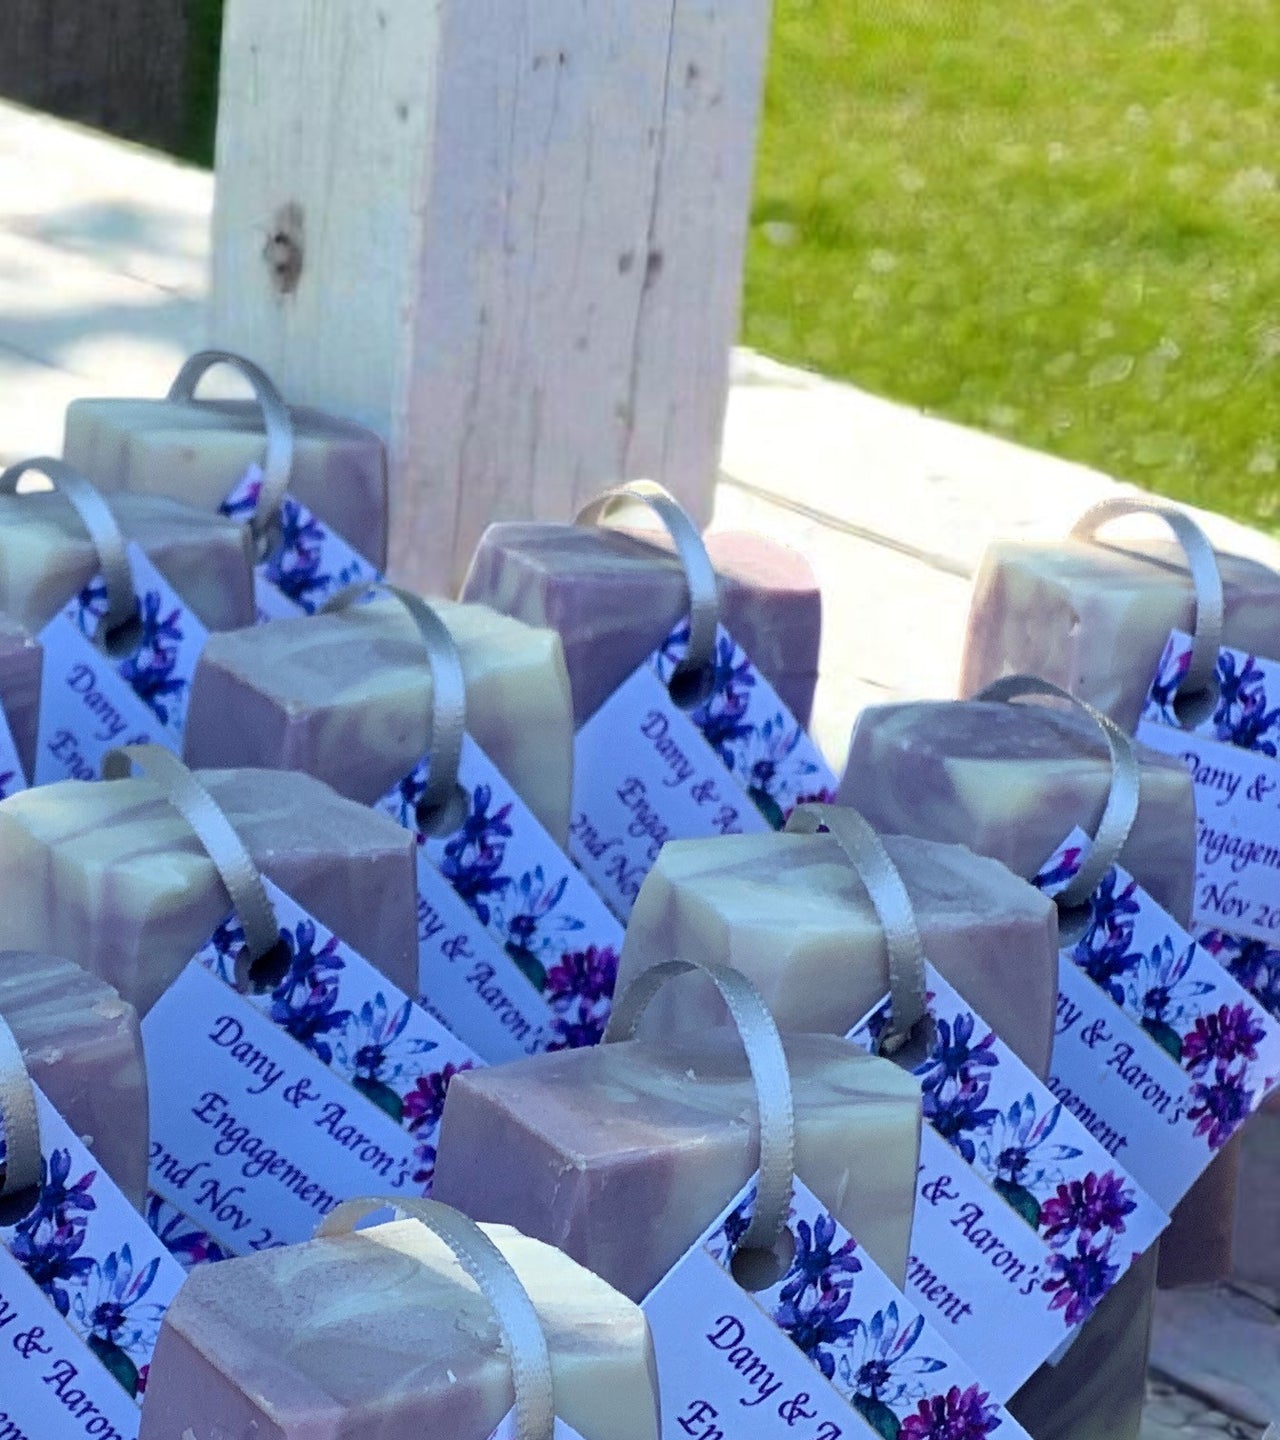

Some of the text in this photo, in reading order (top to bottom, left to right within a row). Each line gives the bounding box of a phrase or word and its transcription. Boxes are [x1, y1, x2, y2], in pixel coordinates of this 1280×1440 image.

[67, 663, 127, 742] Dany
[641, 710, 695, 787] Dany
[692, 780, 720, 805] &
[1247, 774, 1276, 802] &
[441, 935, 473, 962] &
[1200, 881, 1280, 930] Nov 20
[209, 1016, 414, 1188] Dany & Aaron's
[1054, 992, 1188, 1125] ny & Aaron's
[192, 1092, 343, 1215] Engagemen
[194, 1178, 251, 1232] Nov
[921, 1176, 959, 1206] &
[951, 1202, 1040, 1296] Aaron's
[13, 1327, 52, 1359] &
[707, 1315, 783, 1406] Dany
[779, 1393, 817, 1426] &
